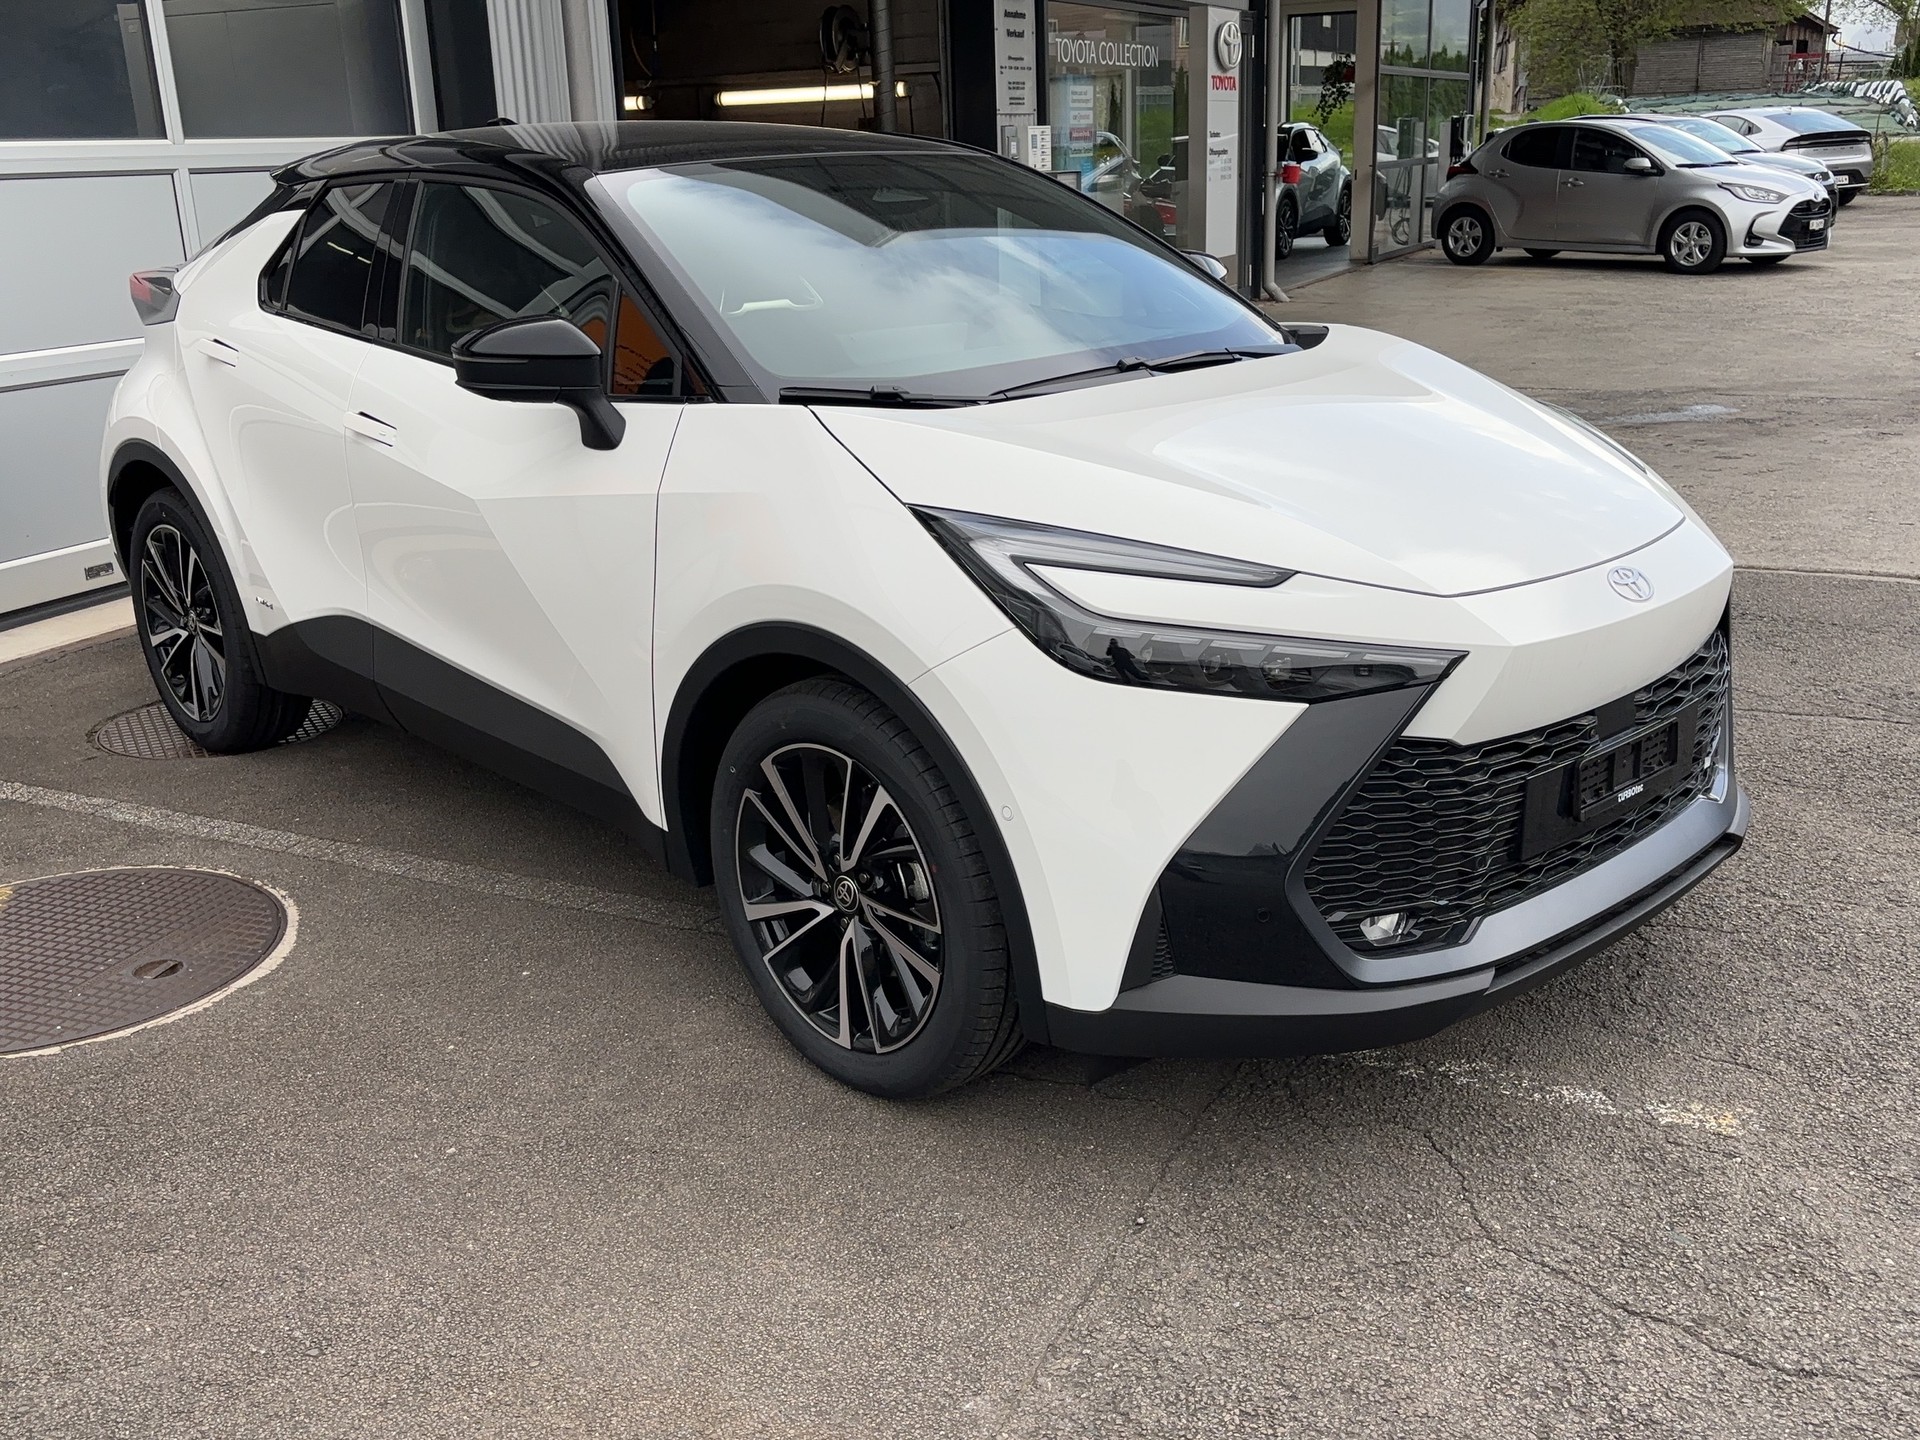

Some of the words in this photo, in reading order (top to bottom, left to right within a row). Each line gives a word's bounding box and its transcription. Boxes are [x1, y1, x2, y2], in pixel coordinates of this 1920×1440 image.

[1006, 29, 1025, 38] Verkauf
[1055, 38, 1097, 64] TOYOTA
[1098, 41, 1159, 67] COLLECTION
[1211, 74, 1237, 91] TOYOTA
